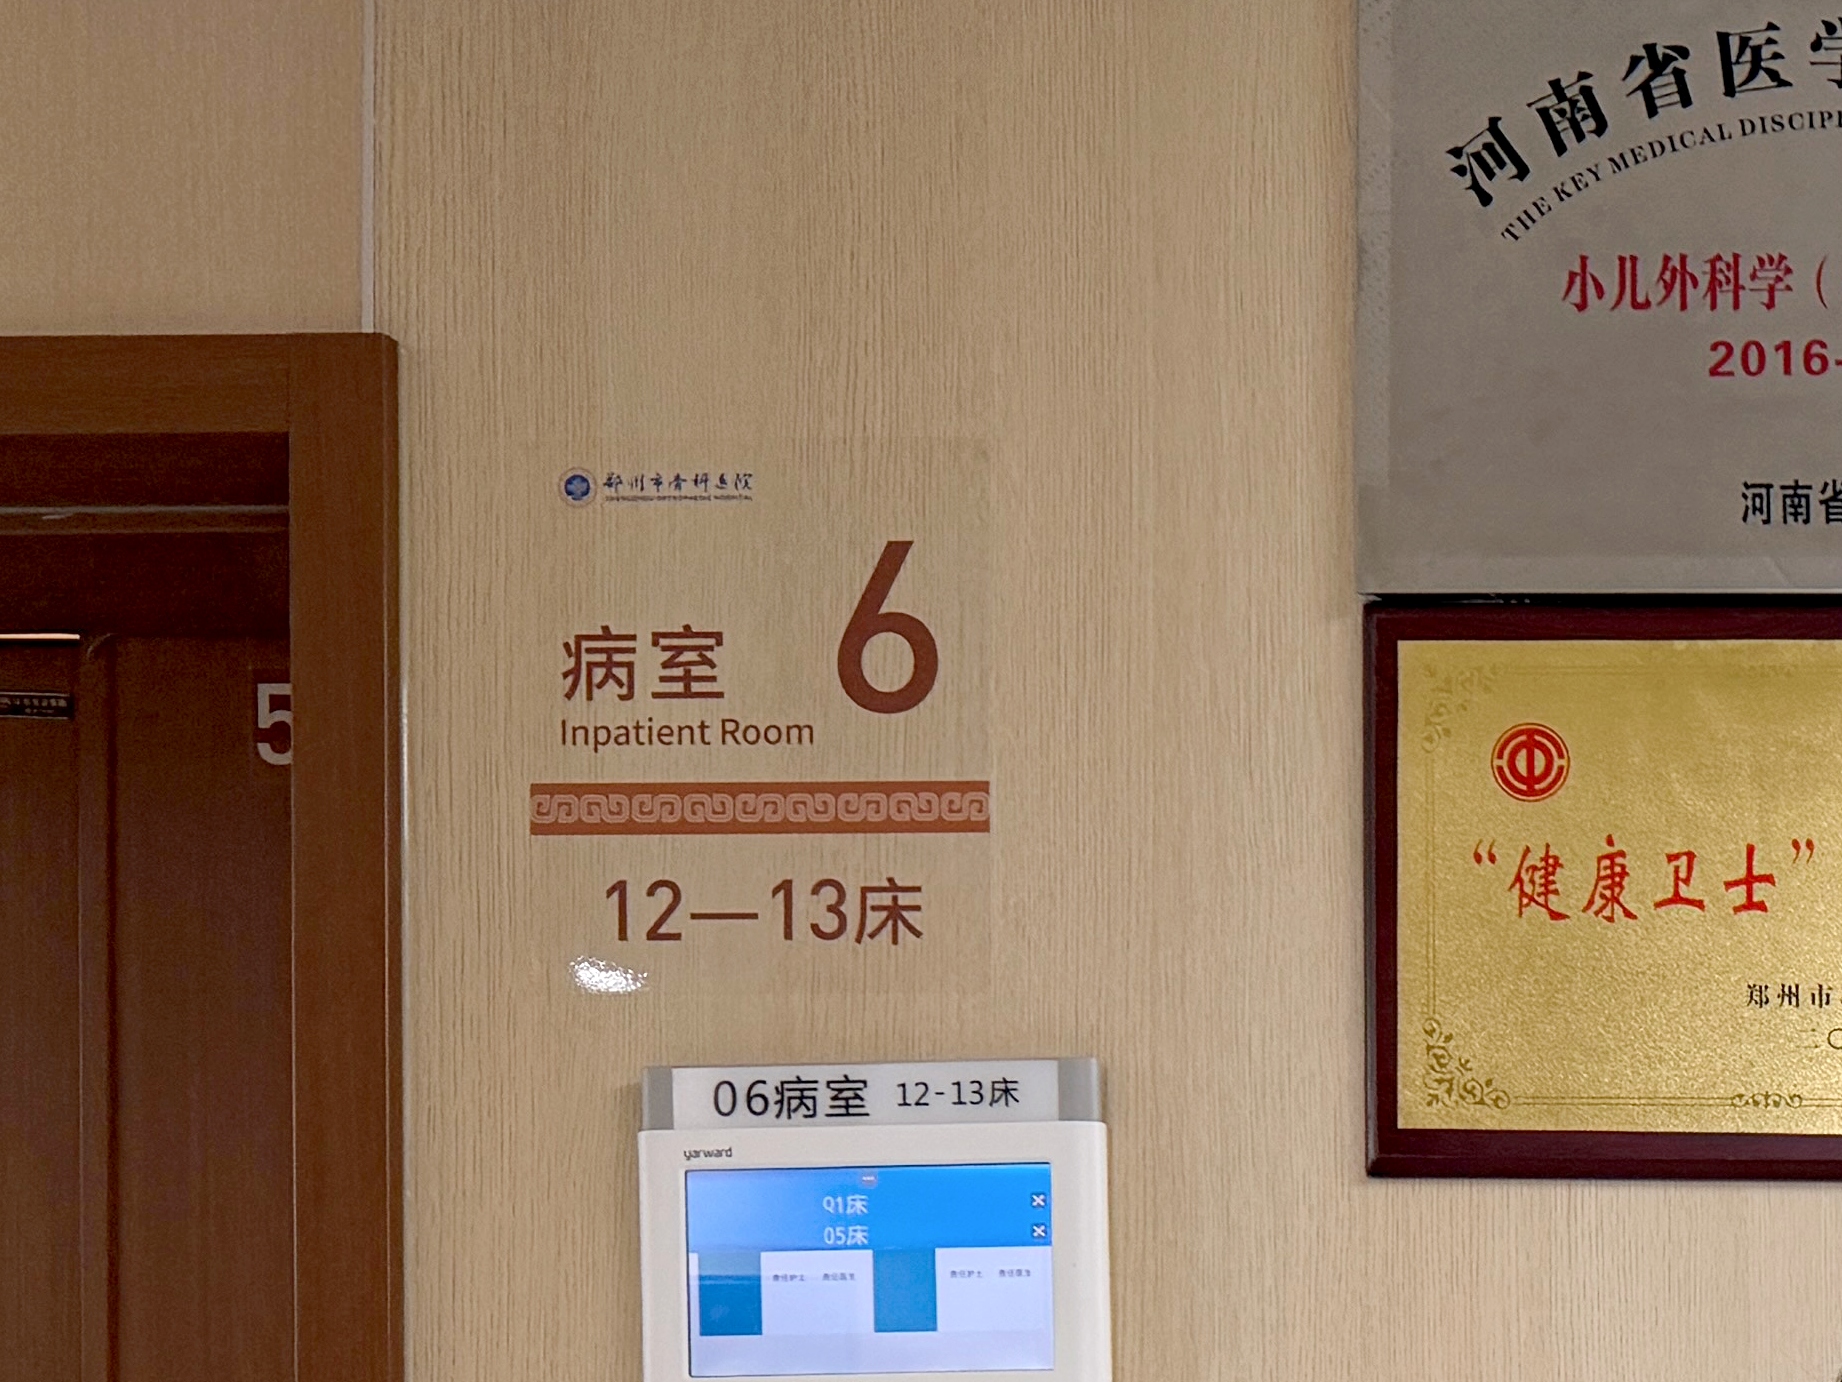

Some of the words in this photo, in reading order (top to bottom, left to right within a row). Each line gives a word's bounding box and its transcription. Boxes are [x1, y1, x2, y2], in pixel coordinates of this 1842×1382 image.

[1501, 196, 1552, 243] THE
[1557, 163, 1604, 203] KEY
[1607, 123, 1733, 175] MEDICAL
[561, 624, 725, 702] 病室
[837, 540, 939, 714] 6
[256, 682, 292, 765] 5
[560, 717, 712, 754] Inpatient
[720, 718, 815, 747] Room
[712, 1074, 871, 1120] 06病室
[896, 1076, 1020, 1109] 12-13床
[684, 1147, 733, 1160] yarward
